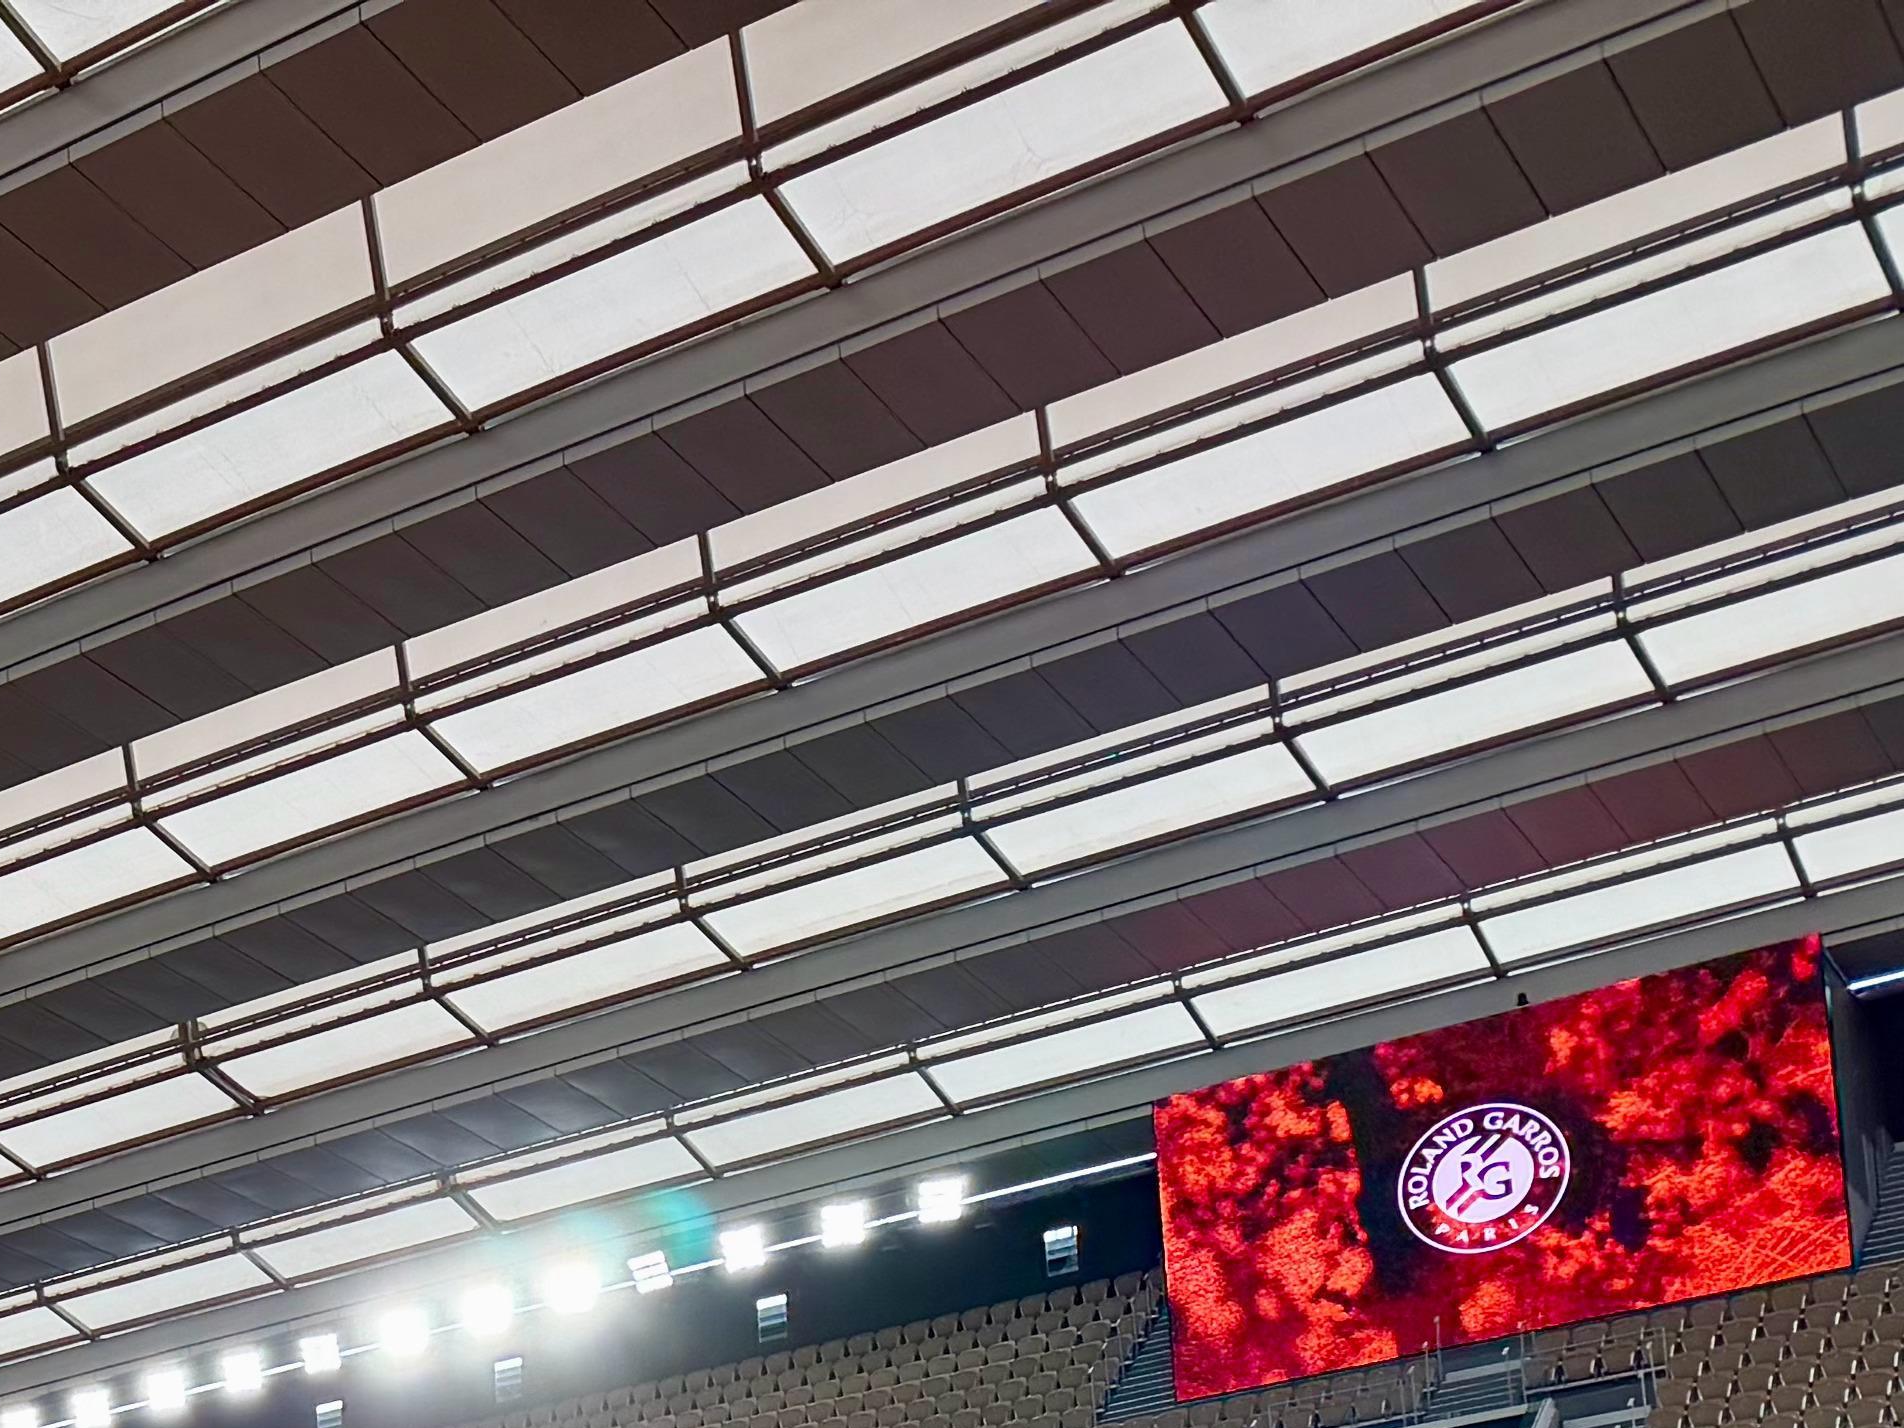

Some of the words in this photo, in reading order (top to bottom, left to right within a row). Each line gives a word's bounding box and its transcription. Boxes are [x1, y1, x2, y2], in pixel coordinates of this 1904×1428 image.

[1408, 1118, 1474, 1209] ROLAND
[1483, 1111, 1560, 1179] GARROS
[1435, 1203, 1539, 1244] PARIS
